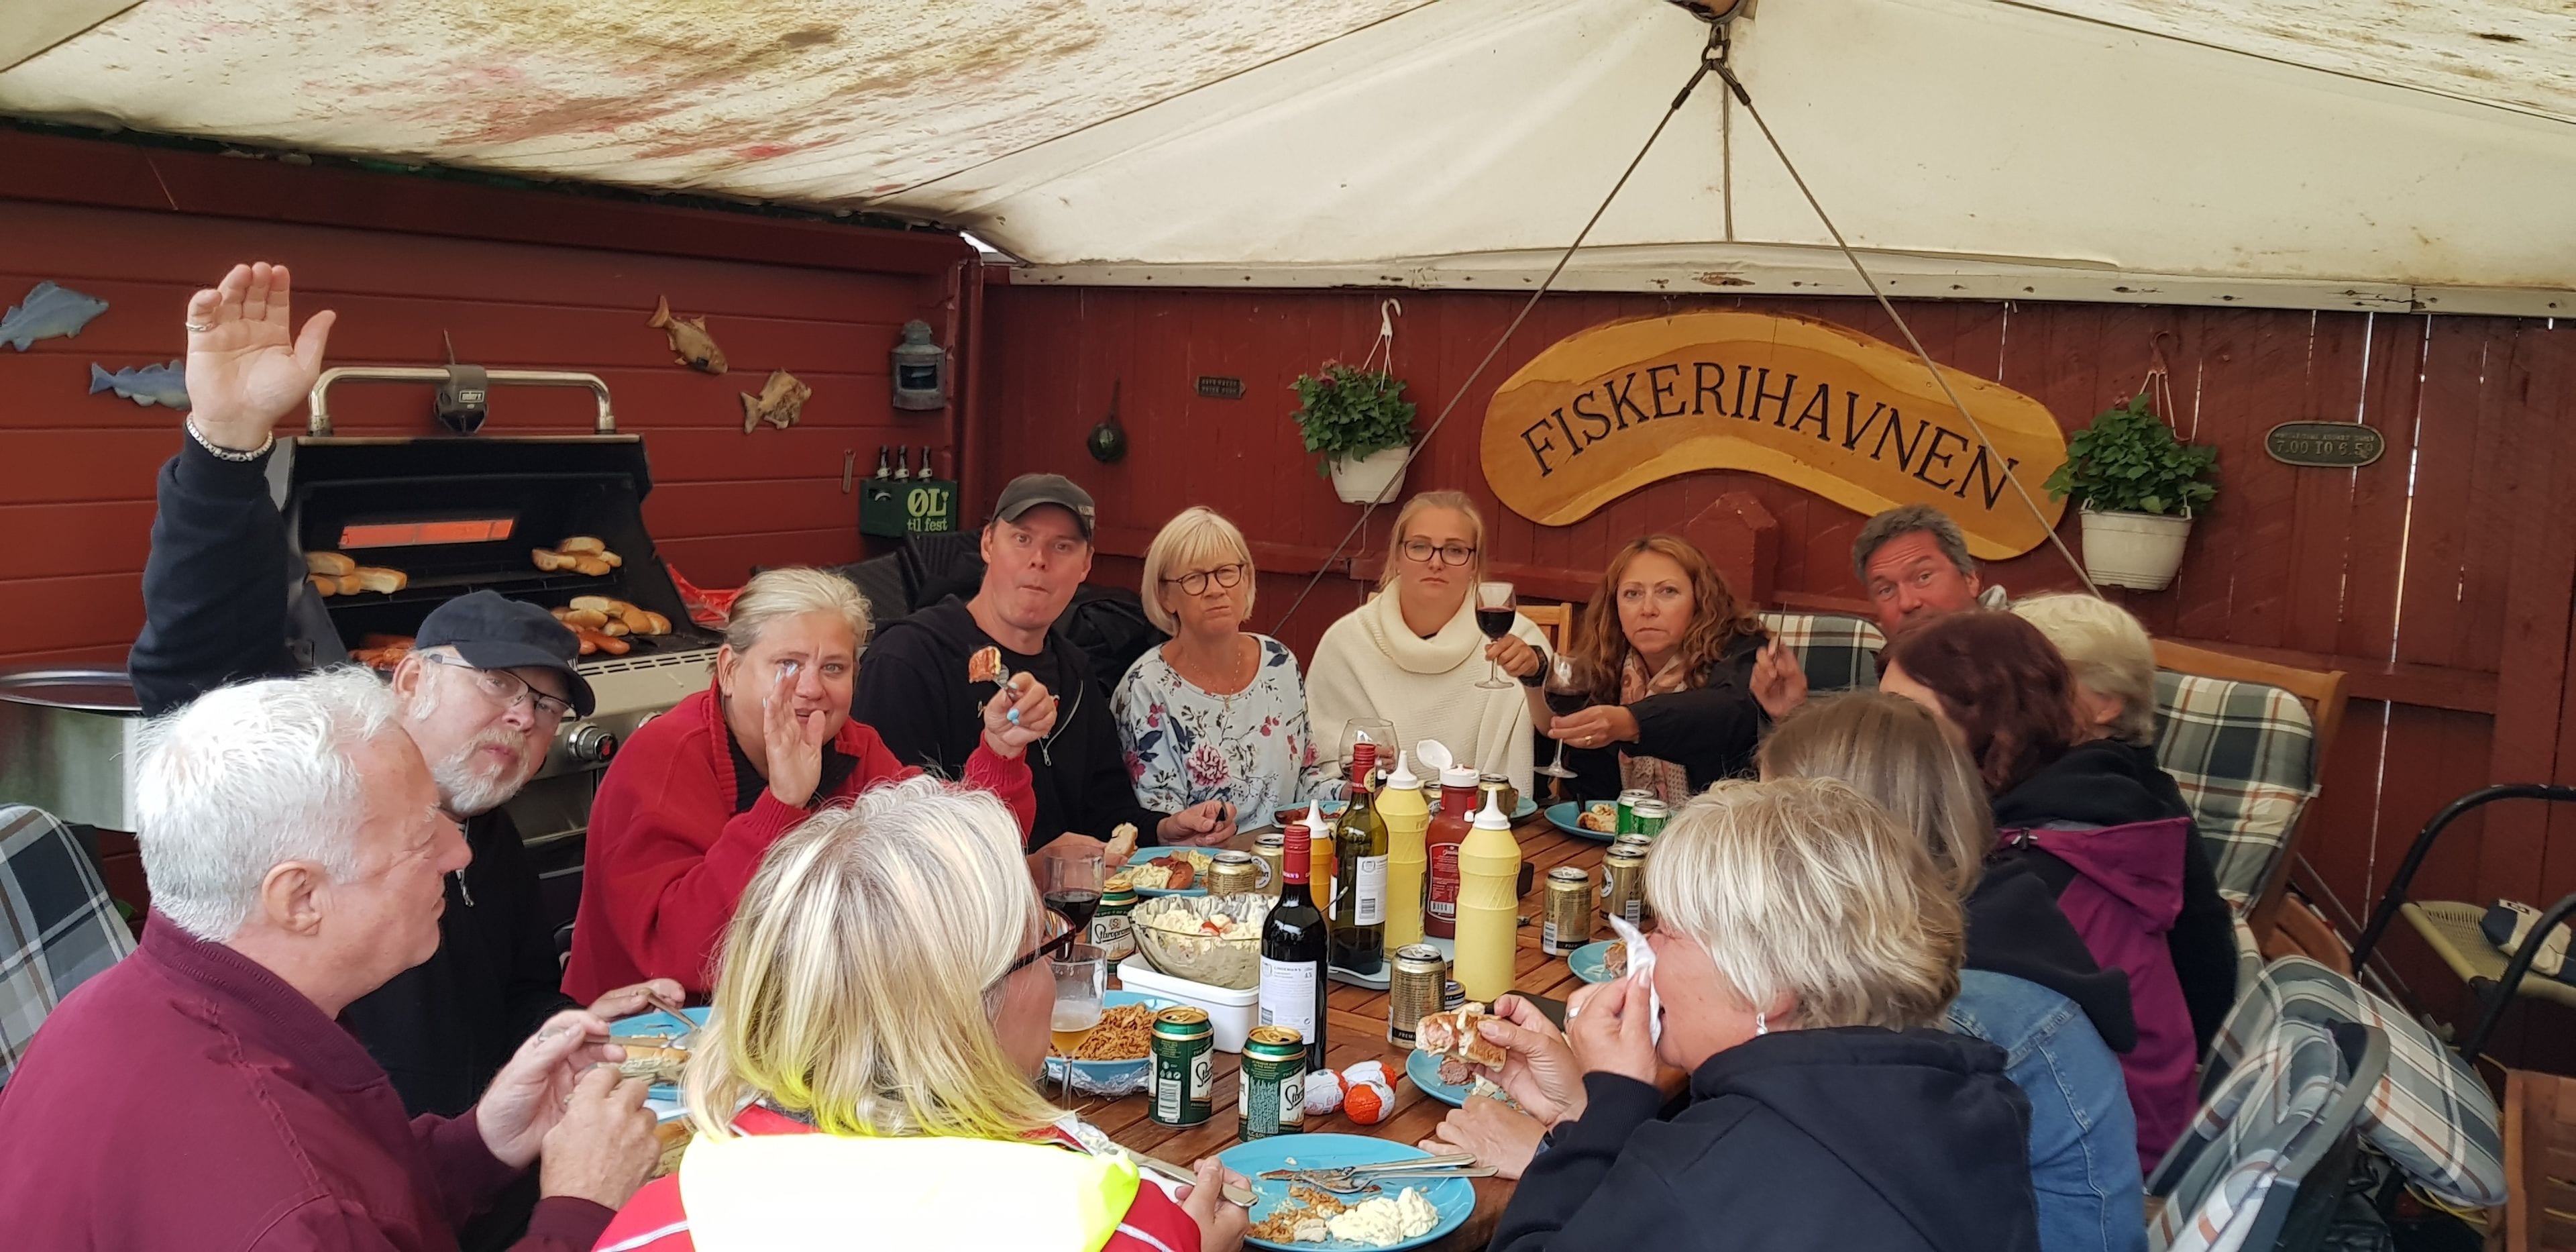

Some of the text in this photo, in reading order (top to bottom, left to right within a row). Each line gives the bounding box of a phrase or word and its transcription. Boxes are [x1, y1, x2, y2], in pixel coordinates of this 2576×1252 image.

[1520, 361, 2019, 511] FISKERIHAVNEN
[907, 488, 948, 517] ØL
[906, 517, 948, 532] til fest
